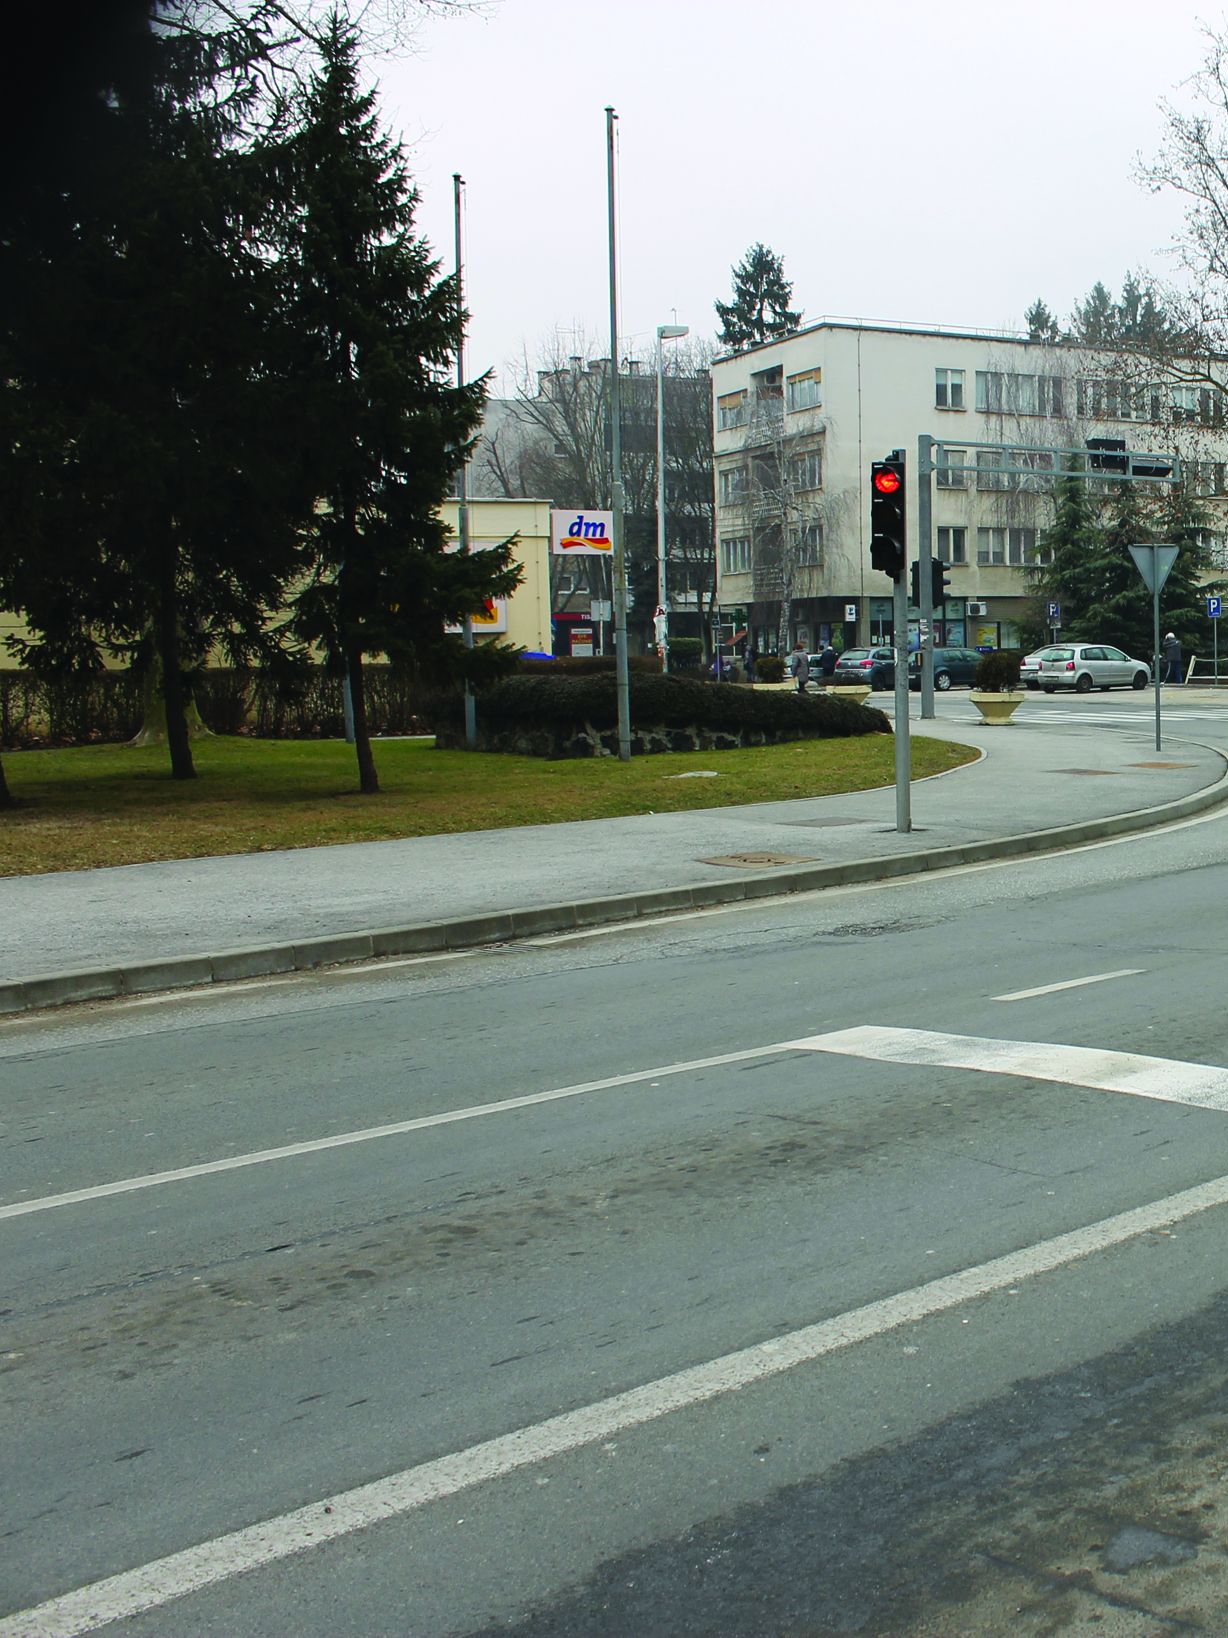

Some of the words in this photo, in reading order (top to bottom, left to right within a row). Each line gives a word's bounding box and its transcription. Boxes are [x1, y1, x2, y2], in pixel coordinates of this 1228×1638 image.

[568, 515, 606, 538] dm
[1049, 603, 1057, 616] P
[1210, 599, 1218, 613] P
